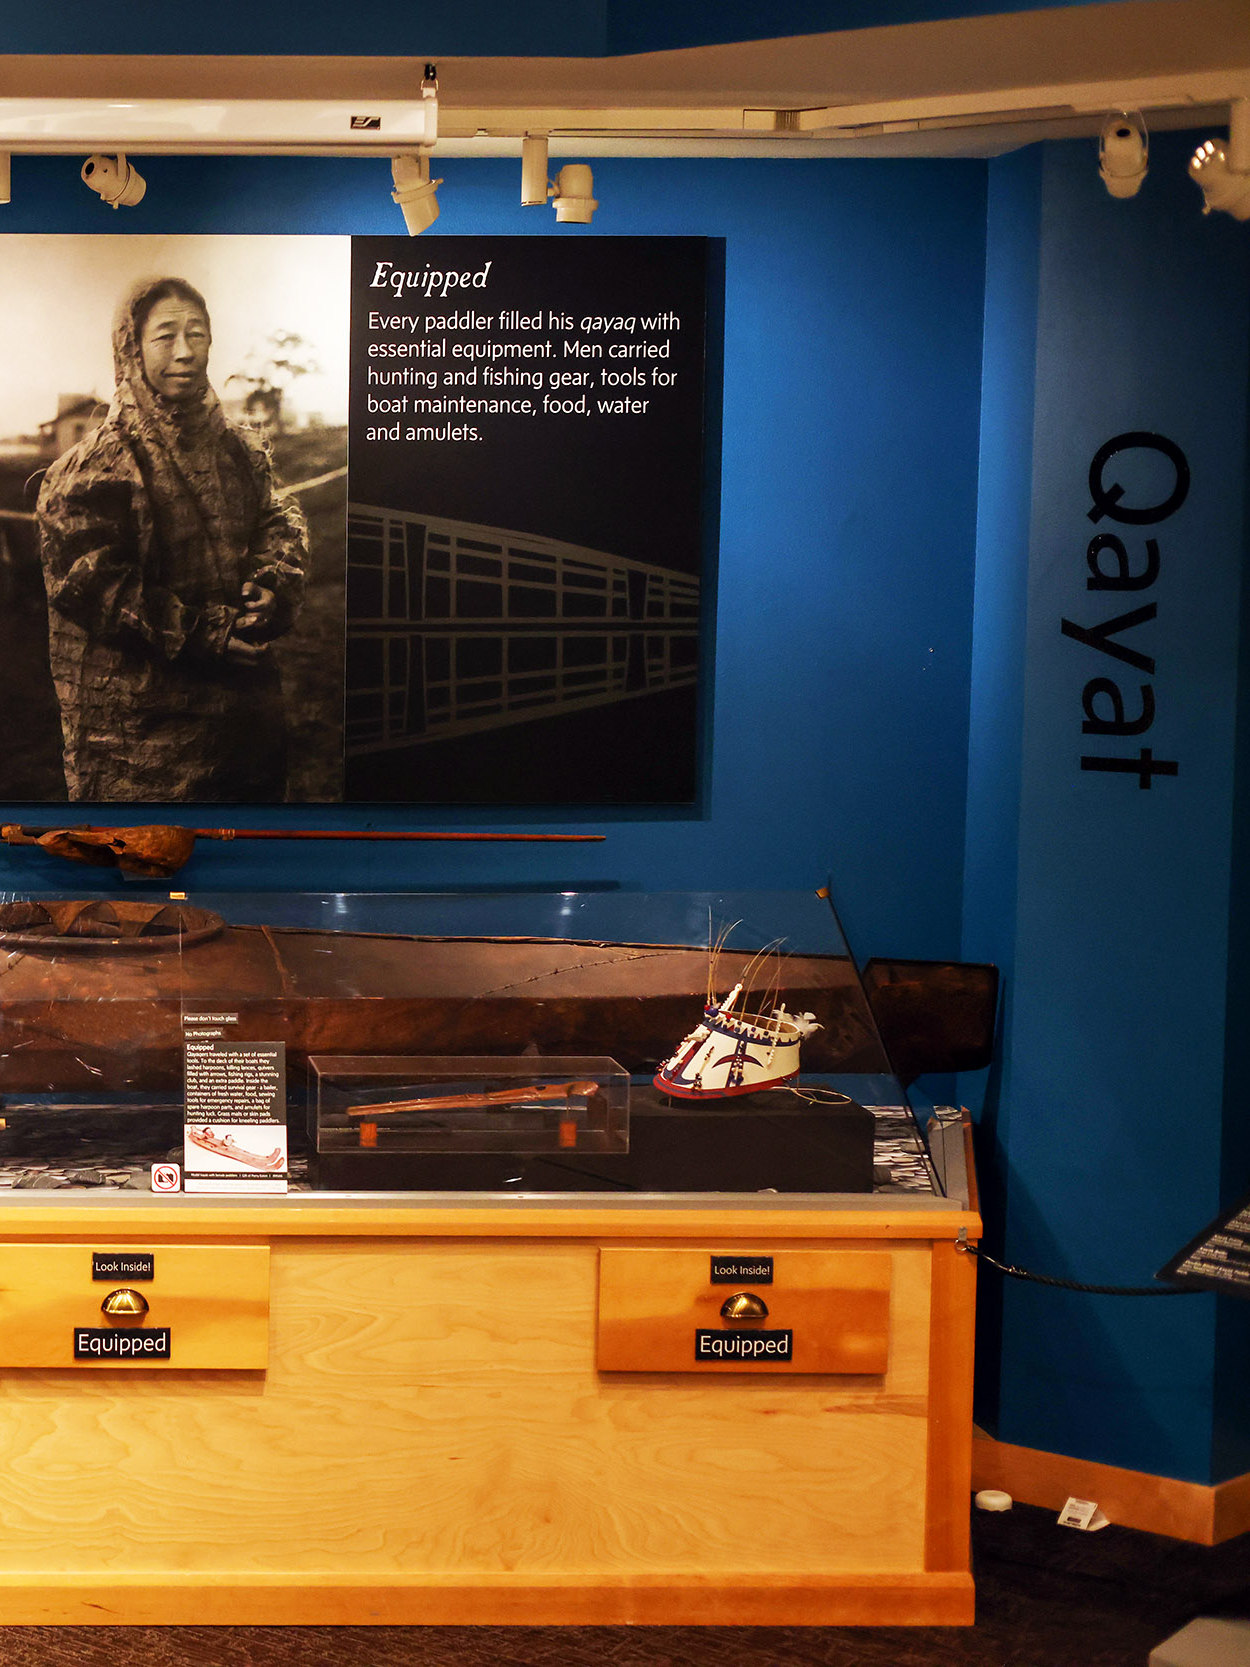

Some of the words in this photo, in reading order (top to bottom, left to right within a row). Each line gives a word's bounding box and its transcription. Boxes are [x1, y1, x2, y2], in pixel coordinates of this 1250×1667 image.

[369, 261, 493, 298] Equipped
[368, 311, 420, 334] Every
[425, 310, 494, 334] paddler
[498, 310, 543, 330] filled
[548, 310, 574, 330] his
[580, 316, 636, 334] qayaq
[640, 311, 680, 330] with
[367, 338, 446, 358] essential
[451, 339, 557, 362] equipment.
[563, 340, 603, 358] Men
[608, 338, 670, 359] carried
[367, 365, 438, 390] hunting
[443, 365, 477, 386] and
[482, 366, 543, 390] fishing
[549, 372, 595, 390] gear,
[600, 366, 646, 386] tools
[651, 366, 678, 386] for
[367, 393, 409, 413] boat
[414, 395, 537, 417] maintenance,
[542, 394, 591, 417] food,
[597, 396, 650, 414] water
[366, 421, 400, 441] and
[405, 421, 483, 441] amulets.
[1061, 431, 1190, 790] Qayat
[186, 1043, 215, 1051] Equipped
[95, 1261, 119, 1272] Look
[121, 1261, 151, 1272] Inside!
[714, 1265, 738, 1275] Look
[740, 1265, 770, 1275] Inside!
[78, 1331, 166, 1356] Equipped
[700, 1334, 789, 1357] Equipped
